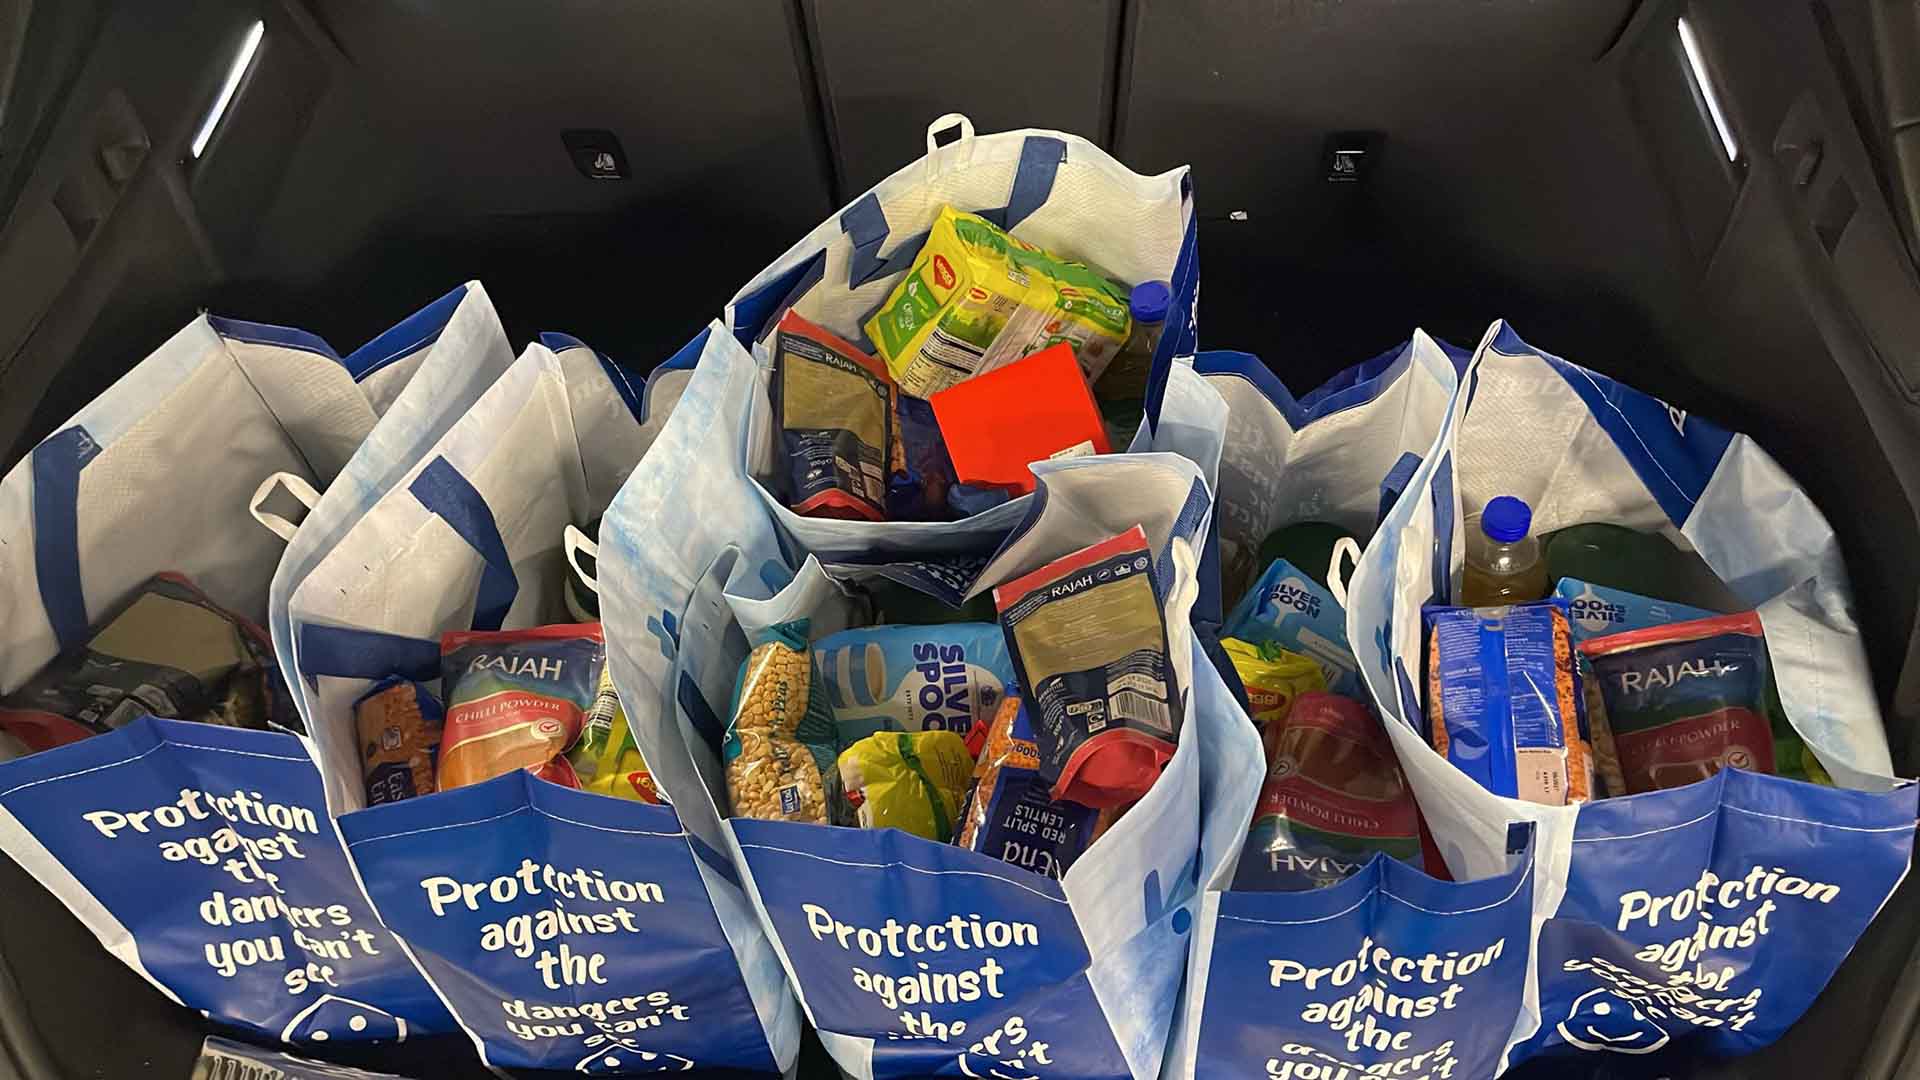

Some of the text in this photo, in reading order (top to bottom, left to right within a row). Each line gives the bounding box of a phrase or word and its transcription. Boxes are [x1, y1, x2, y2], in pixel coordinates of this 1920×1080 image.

[824, 352, 858, 373] RAJAH
[1051, 575, 1094, 598] RAJAH
[1271, 592, 1321, 619] POON
[1272, 584, 1321, 608] ILVER
[1570, 599, 1625, 613] SPOO
[1570, 609, 1625, 623] SILVE
[467, 654, 563, 681] RAJAH
[912, 642, 947, 731] SPOO
[1621, 658, 1724, 696] RAJAH
[940, 644, 972, 738] SILVE
[83, 788, 320, 838] Protection
[1002, 815, 1067, 845] RED SPLIT
[1015, 803, 1065, 829] LENTILS
[1271, 855, 1362, 874] AJAH
[420, 858, 665, 917] Protection
[1617, 866, 1841, 932] Protection
[200, 891, 353, 928] daners
[480, 898, 641, 959] against
[802, 903, 1040, 957] Protection
[1635, 899, 1777, 973] against
[205, 935, 286, 977] you
[535, 943, 609, 990] the
[1268, 935, 1506, 991] Protection
[852, 957, 1005, 1010] against
[502, 991, 671, 1022] dangers
[506, 1004, 691, 1041] you can't
[1301, 978, 1465, 1032] against
[1344, 1014, 1413, 1052] the
[1265, 1058, 1350, 1080] you
